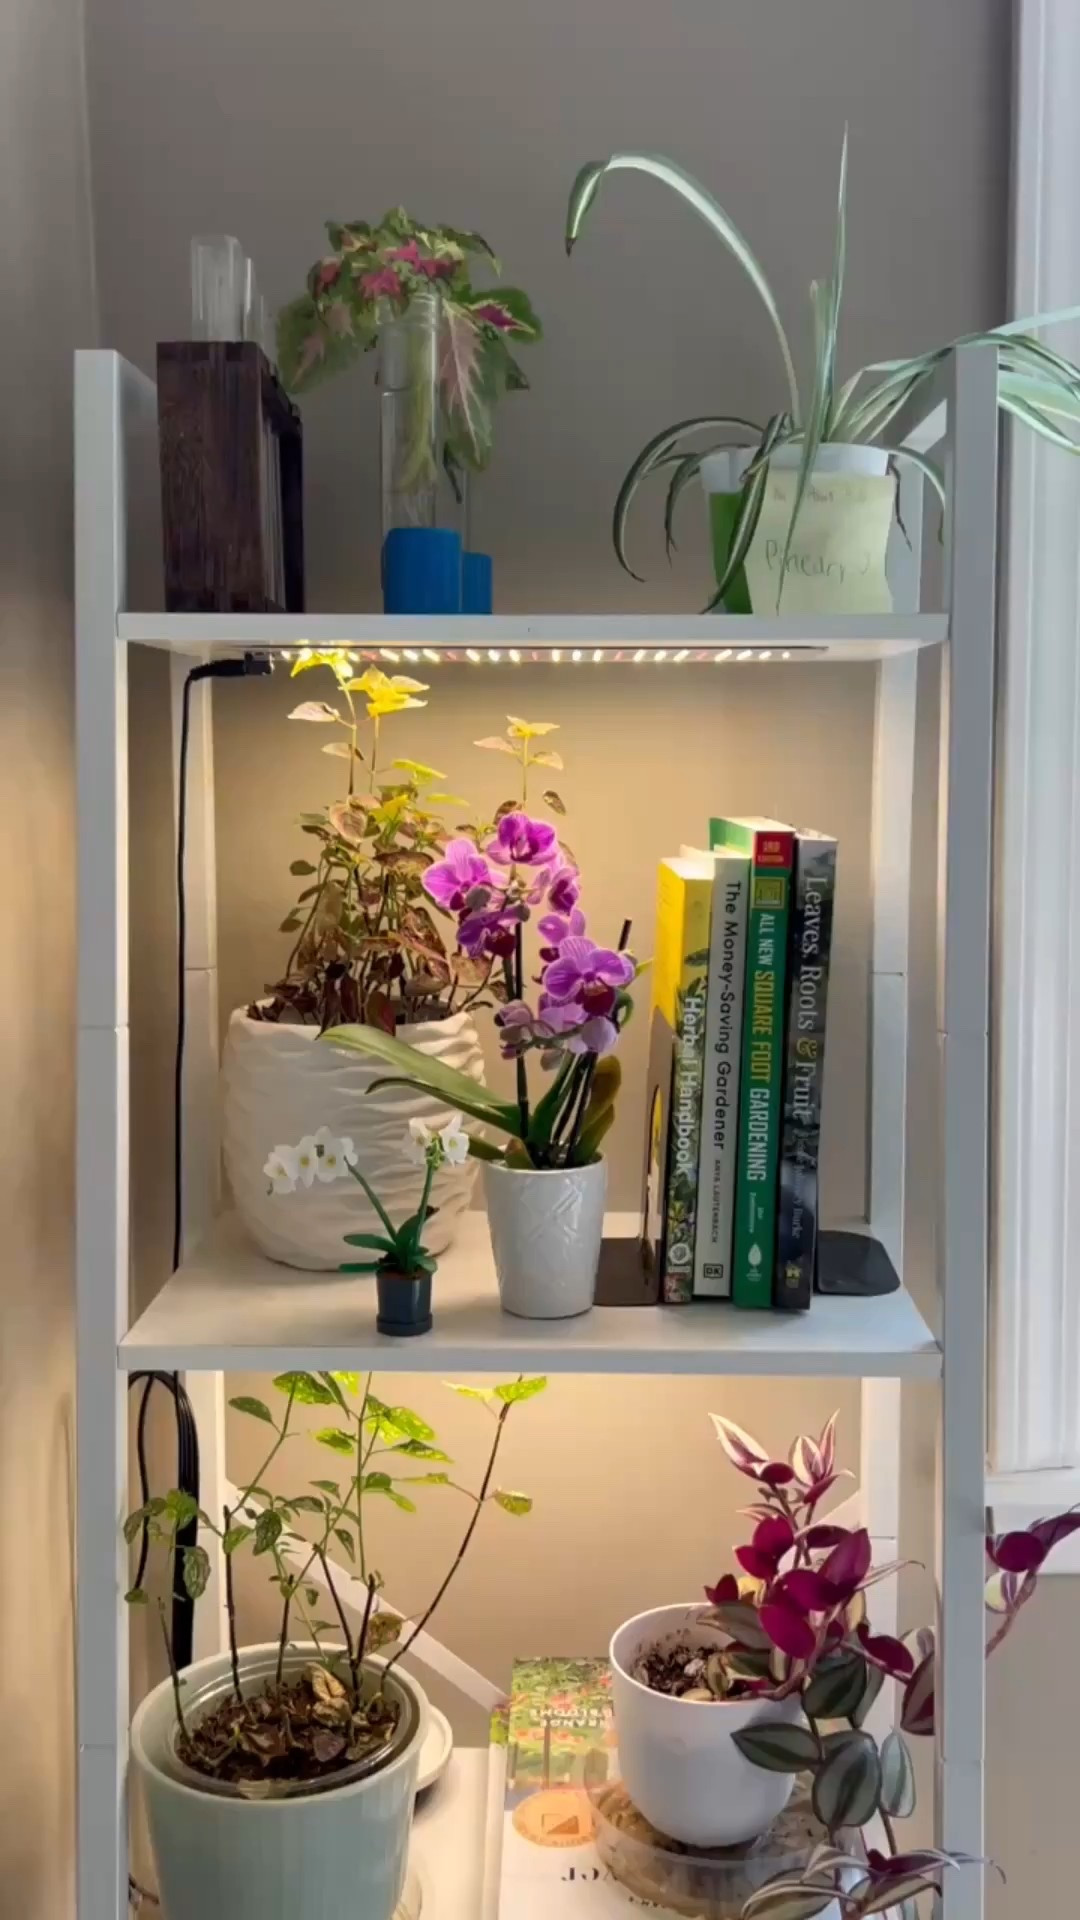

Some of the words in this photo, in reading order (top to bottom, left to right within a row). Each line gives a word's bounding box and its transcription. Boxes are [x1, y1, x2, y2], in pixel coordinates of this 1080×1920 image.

[724, 881, 742, 915] The
[759, 913, 776, 935] ALL
[758, 938, 775, 966] NEW
[713, 919, 739, 1055] Money-Saving
[752, 969, 775, 1036] SQUARE
[797, 964, 822, 1031] Roots
[682, 997, 701, 1065] Herbal
[750, 1041, 773, 1084] FOOT
[796, 1036, 818, 1059] &
[675, 1071, 698, 1176] Handbook
[713, 1061, 732, 1150] Gardener
[792, 1061, 817, 1121] Fruit
[746, 1088, 771, 1182] GARDENING
